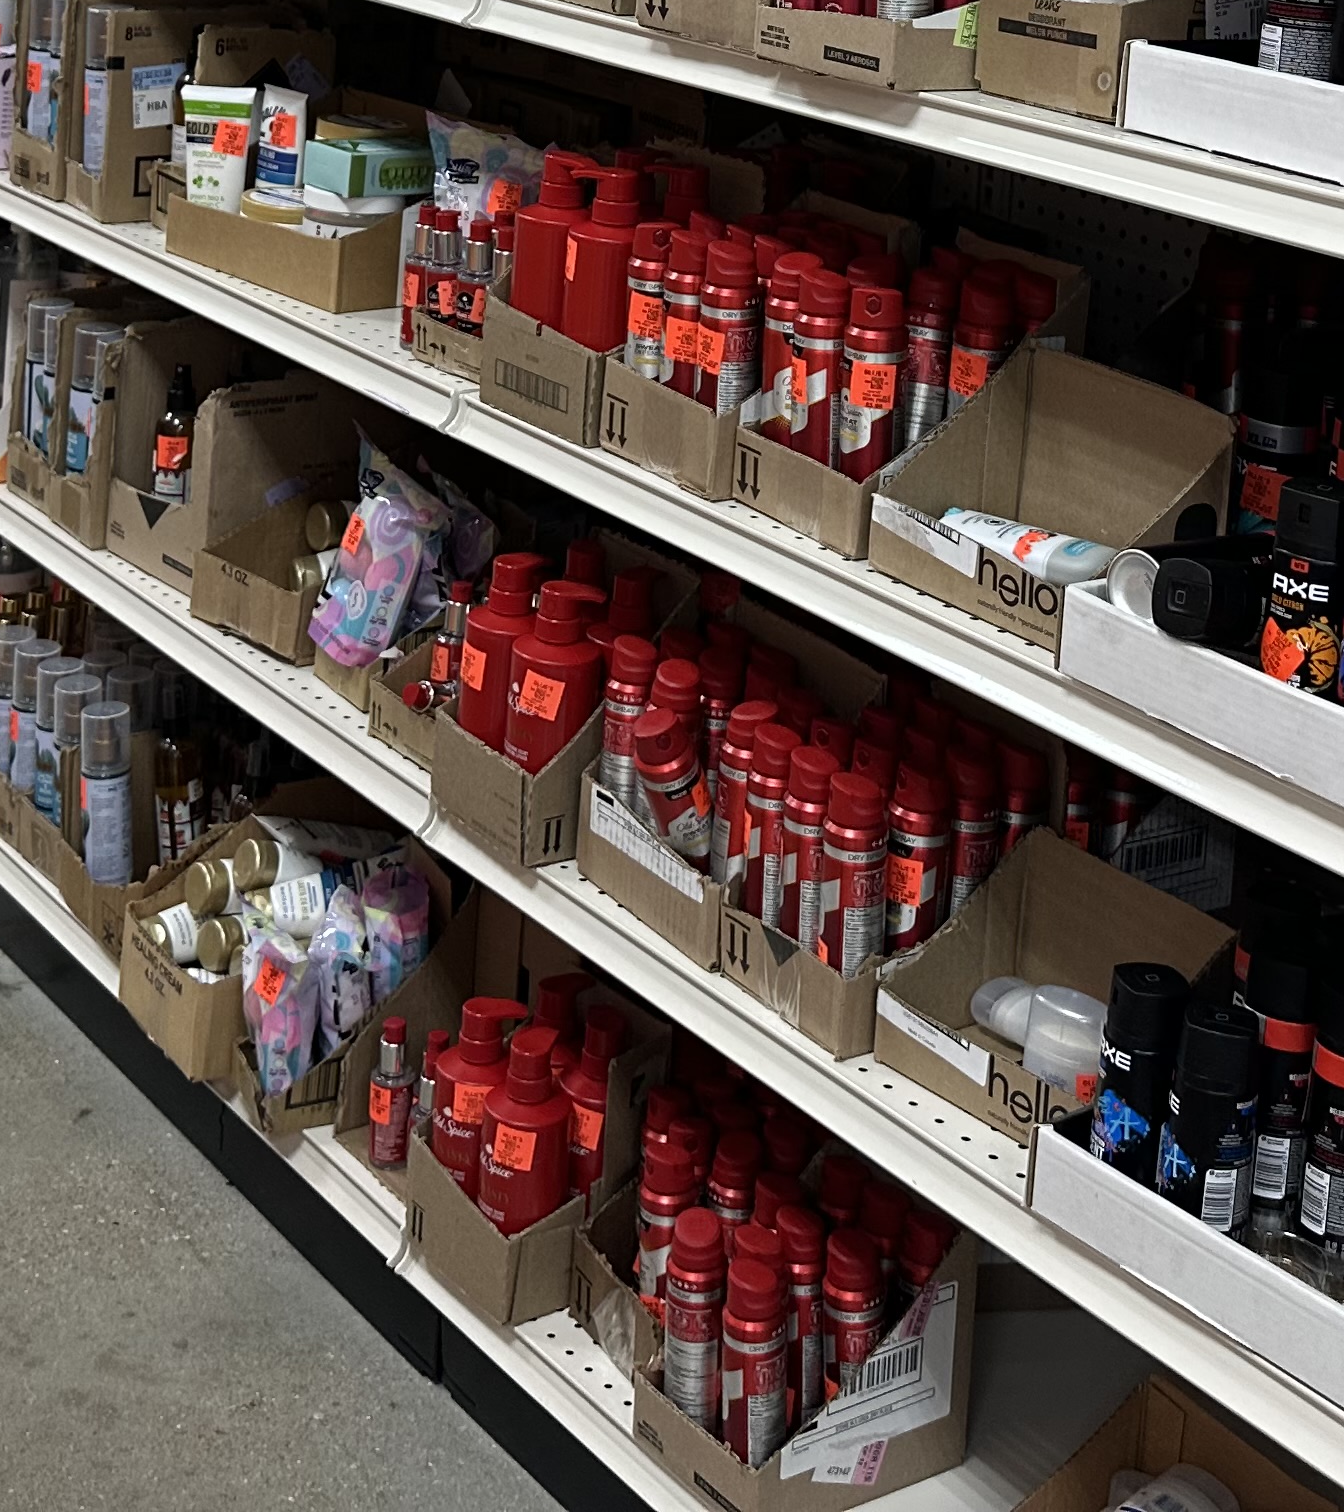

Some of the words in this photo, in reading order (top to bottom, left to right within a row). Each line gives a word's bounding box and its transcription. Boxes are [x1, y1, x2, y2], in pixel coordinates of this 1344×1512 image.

[126, 27, 133, 40] 8
[215, 39, 225, 57] 6
[827, 49, 845, 61] LEVEL
[147, 100, 168, 112] HBA
[186, 121, 210, 136] GOLD
[1272, 572, 1330, 603] AXE
